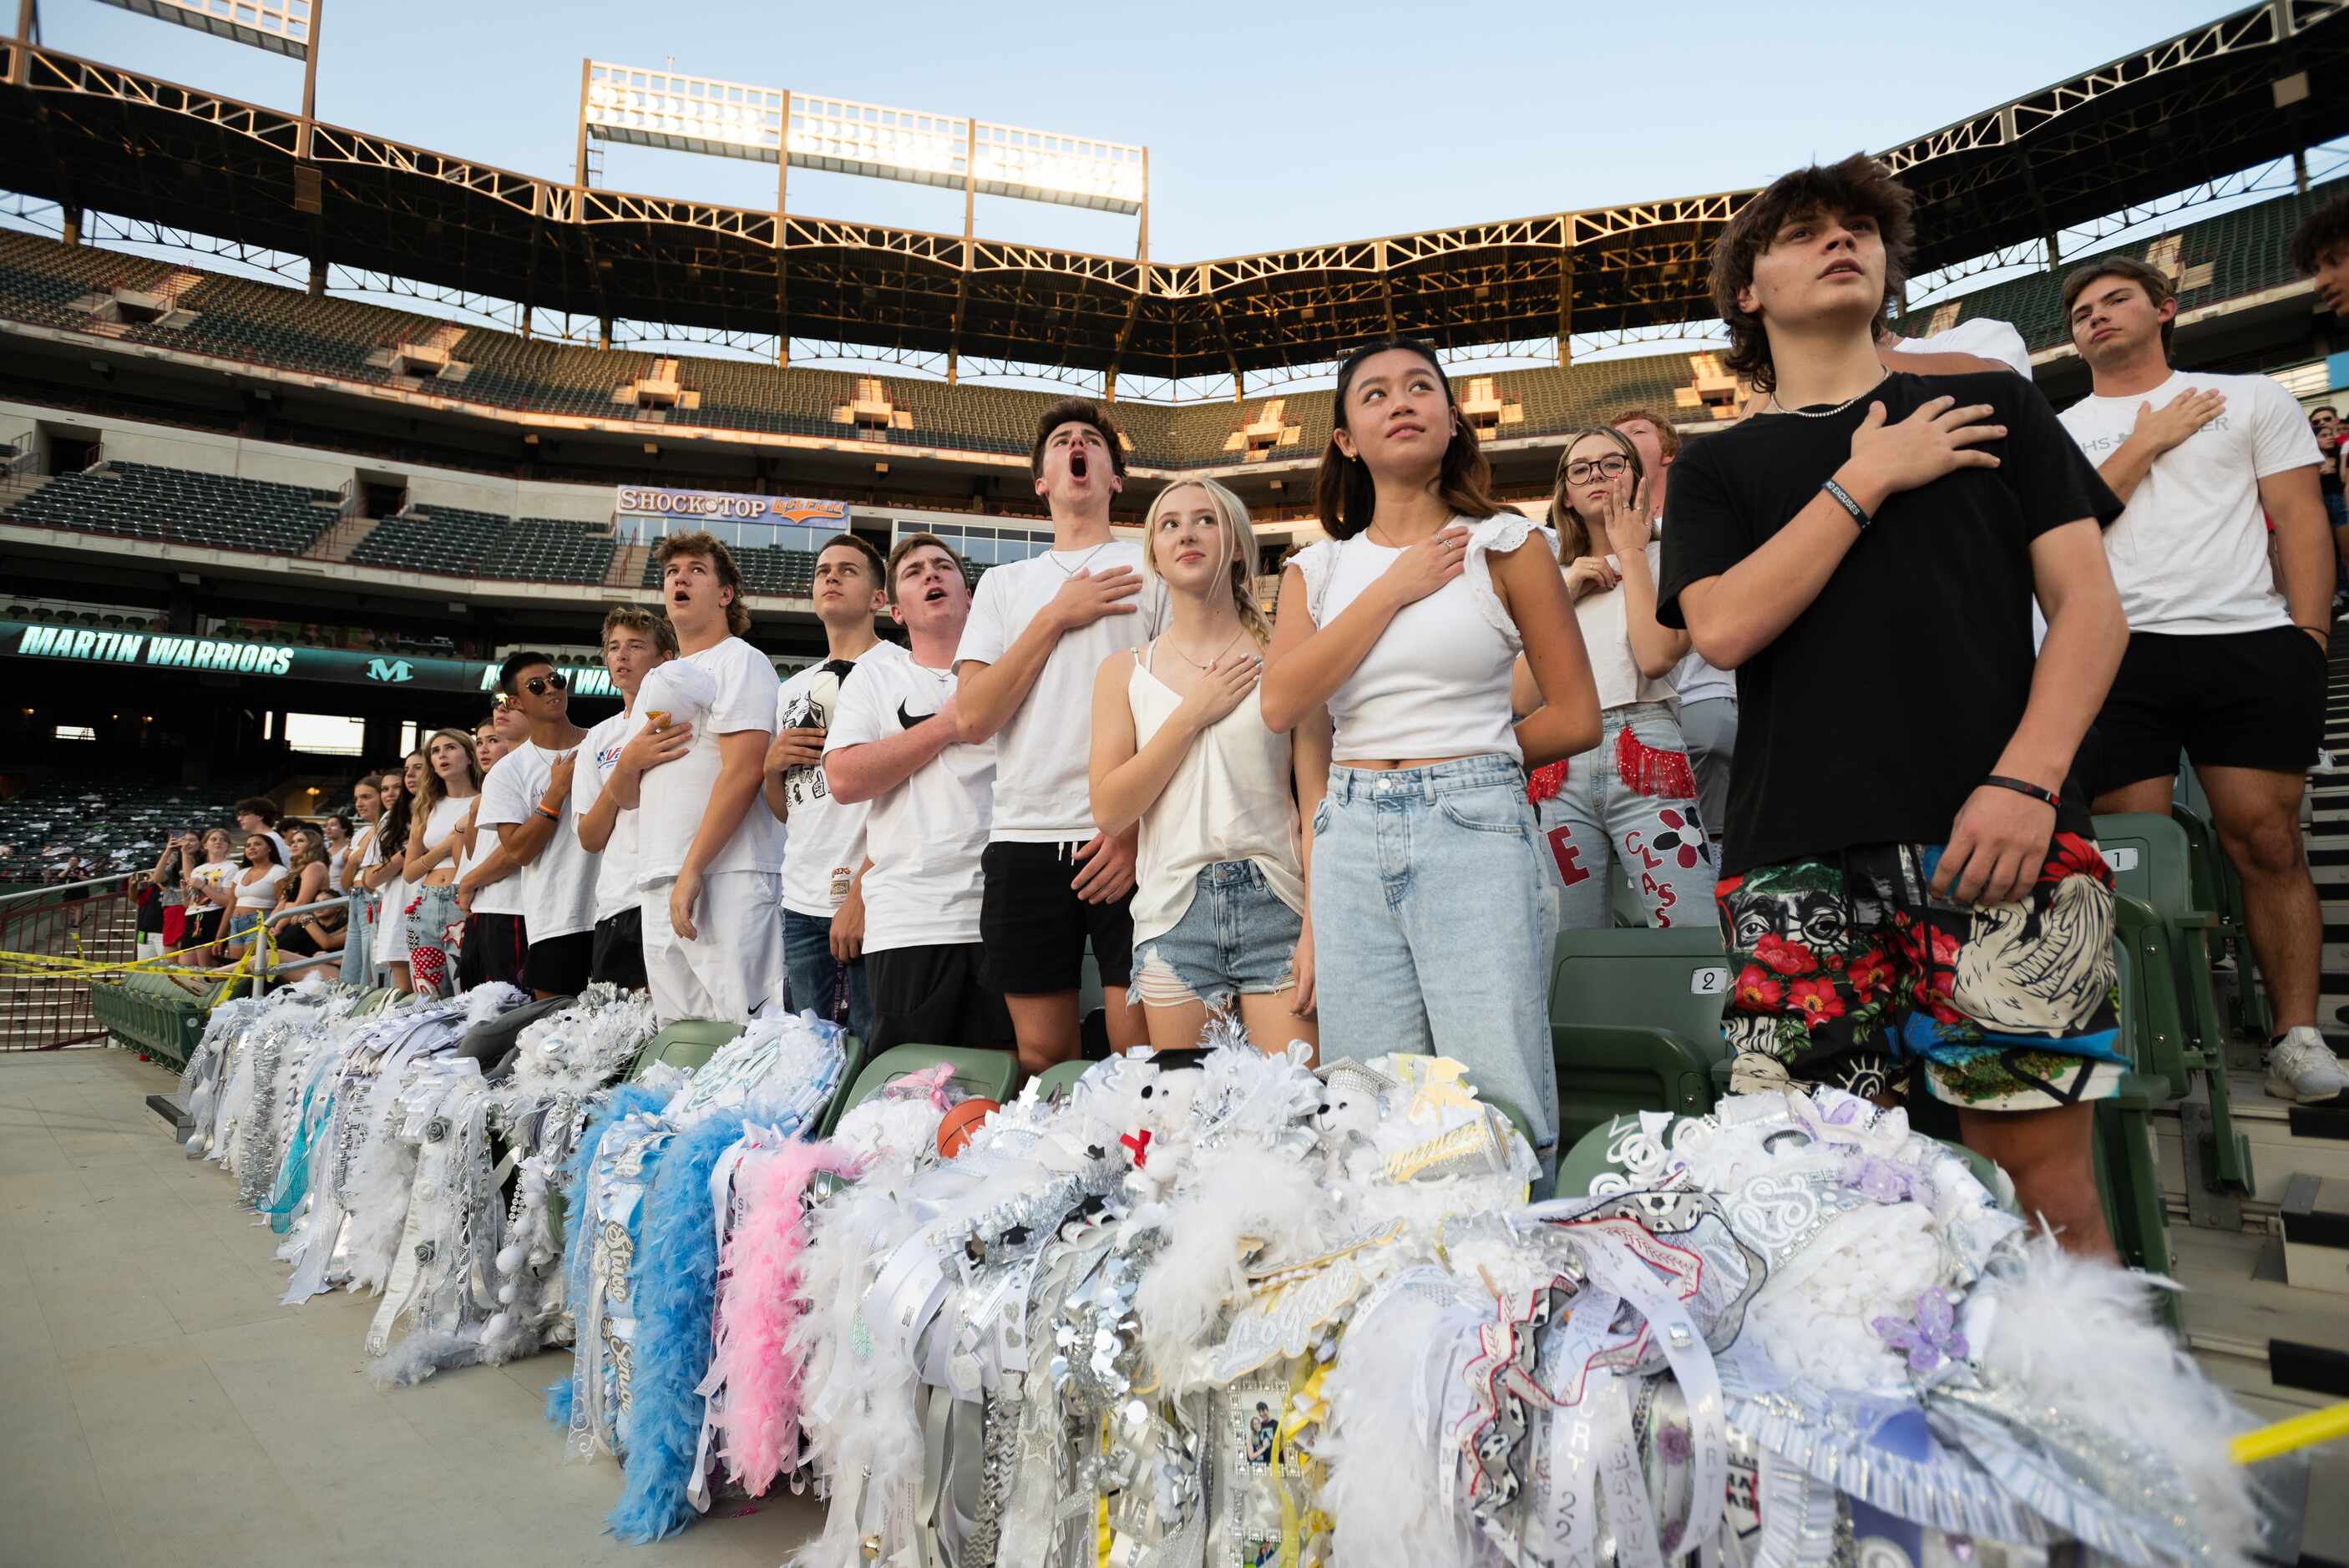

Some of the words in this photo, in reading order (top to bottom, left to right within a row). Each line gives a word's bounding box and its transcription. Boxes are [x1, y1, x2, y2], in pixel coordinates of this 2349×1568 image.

[620, 488, 705, 515] SHOCK
[719, 495, 767, 518] TOP
[1831, 487, 1860, 515] EXCUSES
[18, 625, 144, 663] MARTIN
[146, 636, 295, 675] WARRIORS
[2114, 852, 2120, 867] 1
[1702, 971, 1715, 991] 2
